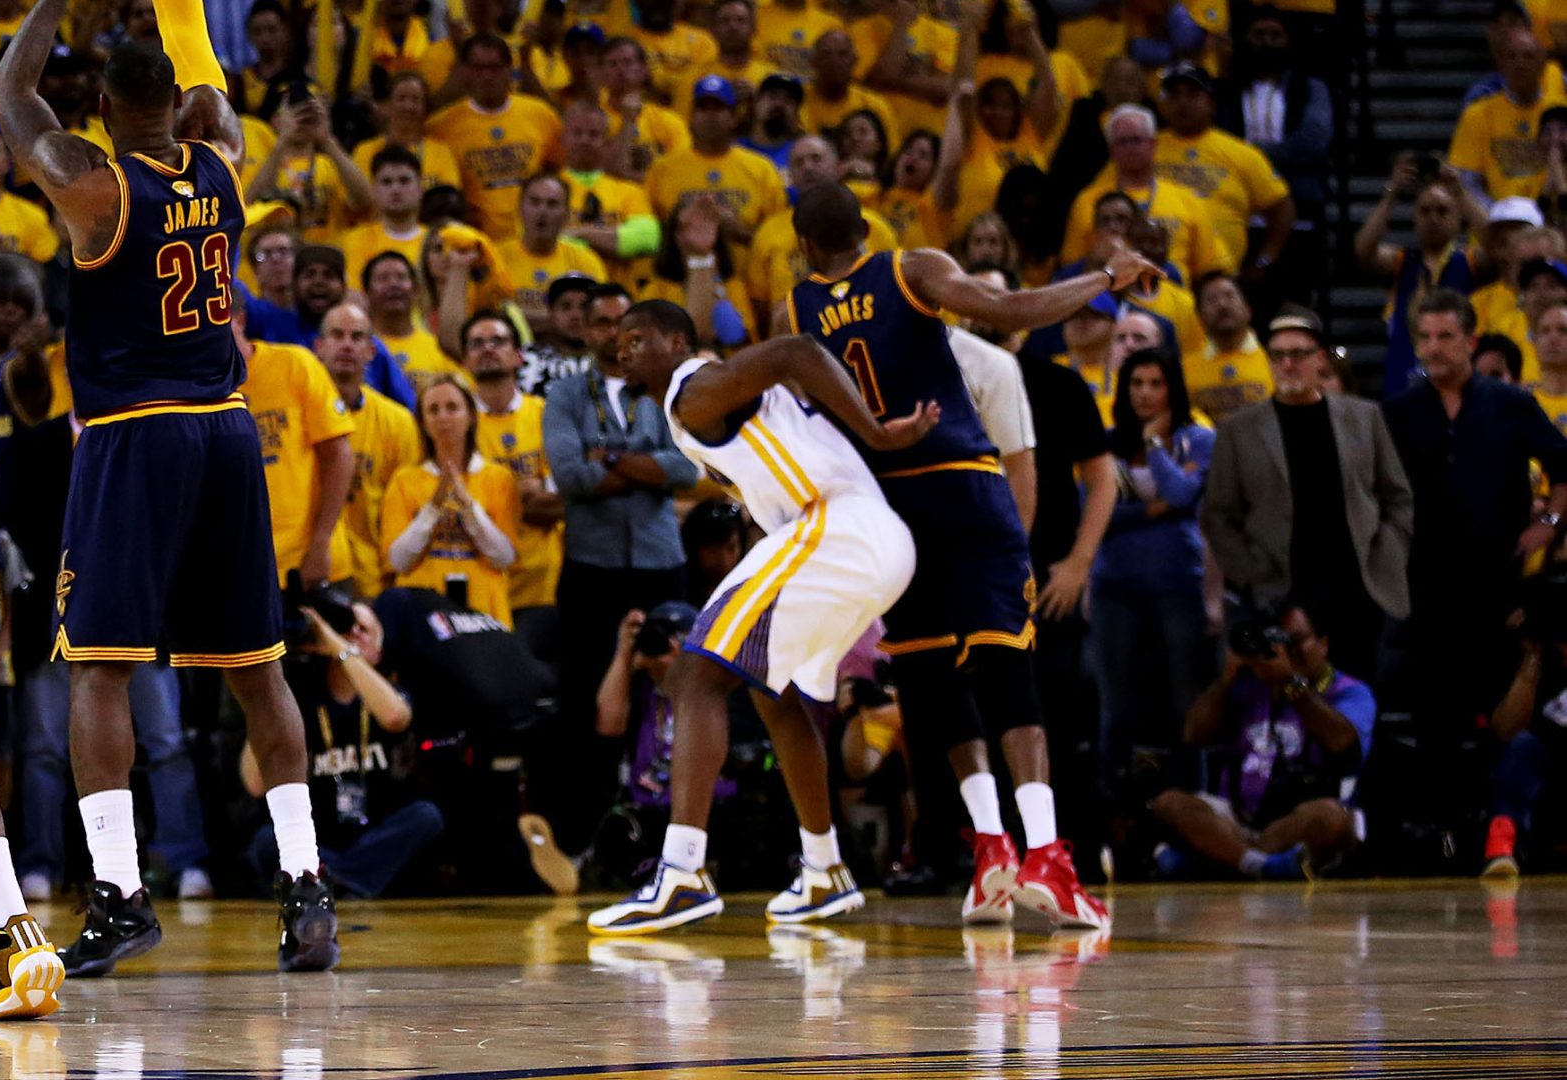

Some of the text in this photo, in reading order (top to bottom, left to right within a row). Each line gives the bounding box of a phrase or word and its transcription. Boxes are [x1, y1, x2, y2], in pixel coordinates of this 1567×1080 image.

[164, 197, 220, 234] JAMES
[156, 232, 232, 335] 23
[818, 293, 874, 337] JONES
[843, 337, 886, 418] 1
